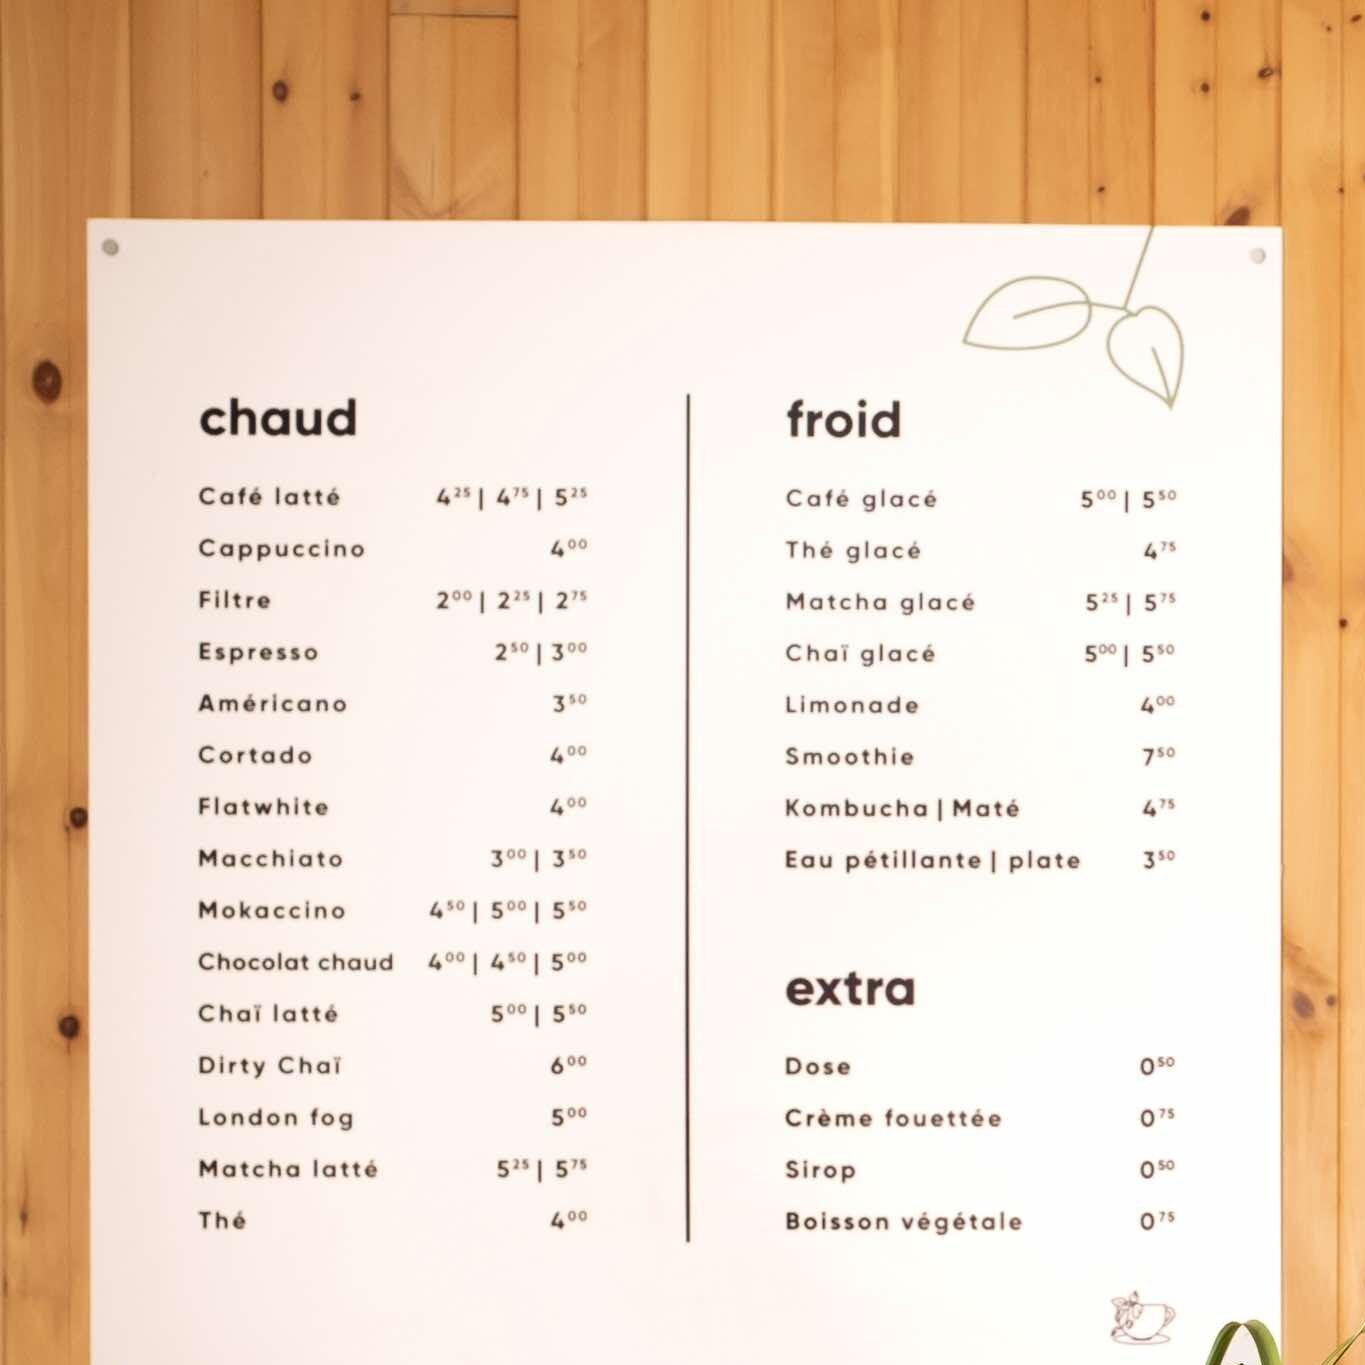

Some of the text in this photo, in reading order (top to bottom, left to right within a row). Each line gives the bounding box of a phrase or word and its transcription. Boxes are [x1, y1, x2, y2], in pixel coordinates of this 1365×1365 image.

[199, 396, 357, 437] chaud
[786, 398, 901, 439] froid
[198, 486, 263, 506] Café
[275, 486, 340, 506] latté
[786, 489, 849, 508] Café
[862, 489, 937, 513] glacé
[198, 538, 365, 563] Cappuccino
[786, 540, 833, 559] Thé
[846, 541, 921, 564] glacé
[199, 589, 271, 609] Filtre
[786, 592, 887, 611] Matcha
[900, 592, 975, 616] glacé
[199, 641, 318, 665] Espresso
[785, 643, 847, 662] Chaï
[860, 643, 935, 667] glacé
[198, 693, 347, 713] Américano
[786, 695, 919, 714] Limonade
[198, 745, 312, 765] Cortado
[785, 746, 914, 766] Smoothie
[198, 796, 329, 816] Flatwhite
[785, 799, 928, 818] Kombucha
[953, 799, 1020, 818] Maté
[198, 848, 343, 868] Macchiato
[785, 850, 833, 869] Eau
[845, 849, 981, 873] pétillante
[1009, 850, 1080, 873] plate
[198, 900, 345, 920] Mokaccino
[198, 952, 309, 971] Chocolat
[318, 953, 393, 971] chaud
[785, 971, 915, 1007] extra
[198, 1003, 261, 1023] Chaï
[273, 1003, 338, 1023] latté
[198, 1055, 266, 1079] Dirty
[277, 1055, 341, 1075] Chaï
[785, 1056, 851, 1076] Dose
[199, 1107, 298, 1127] London
[310, 1107, 353, 1132] fog
[785, 1108, 873, 1128] Crème
[885, 1108, 1001, 1128] fouettée
[199, 1159, 300, 1178] Matcha
[313, 1159, 378, 1178] latté
[786, 1160, 856, 1184] Sirop
[198, 1210, 246, 1230] Thé
[786, 1211, 889, 1231] Boisson
[901, 1211, 1022, 1236] végétale
